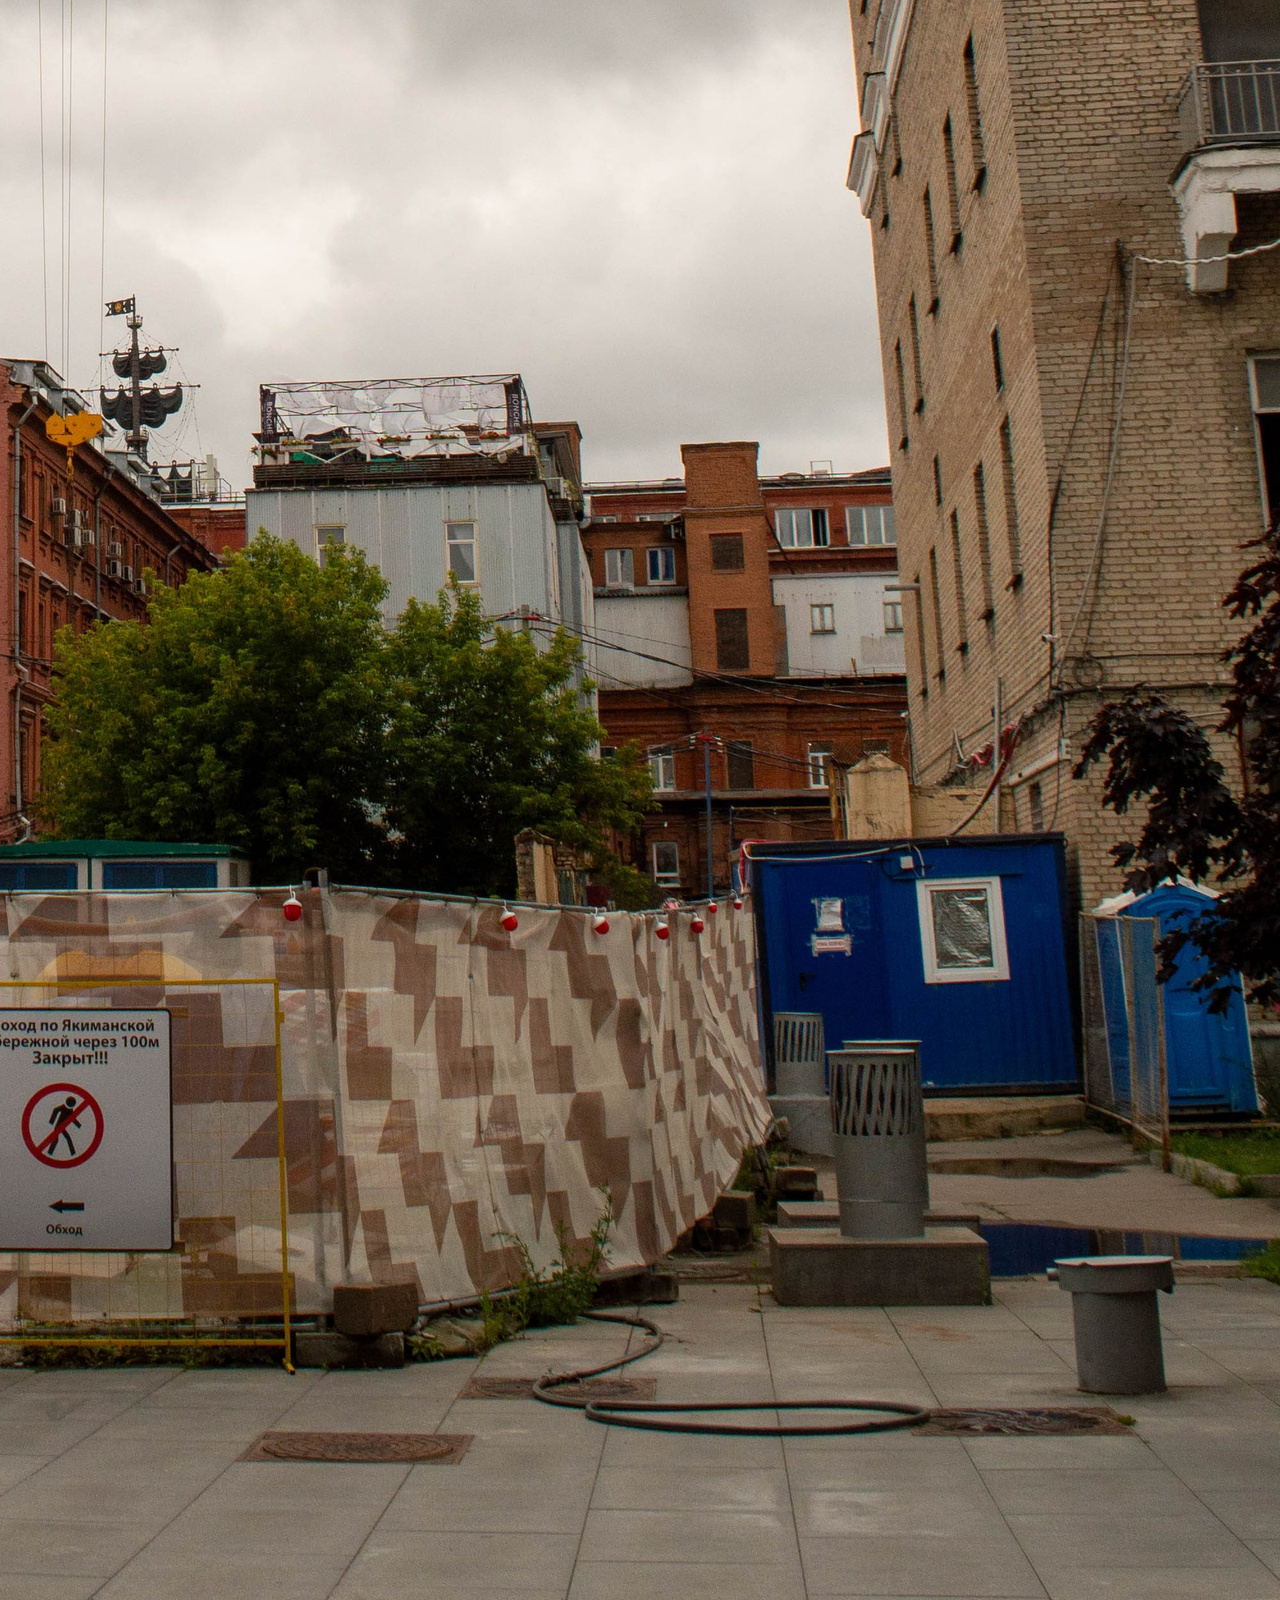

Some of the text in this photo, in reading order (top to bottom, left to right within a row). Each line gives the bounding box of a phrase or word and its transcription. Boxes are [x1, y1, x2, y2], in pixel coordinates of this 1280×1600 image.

[511, 393, 520, 427] BONCHE
[40, 1021, 58, 1032] по
[62, 1018, 155, 1032] Якиманской
[73, 1037, 117, 1050] через
[122, 1036, 160, 1048] 100м
[32, 1051, 108, 1068] Закрыт!!!
[46, 1223, 83, 1236] Обход
